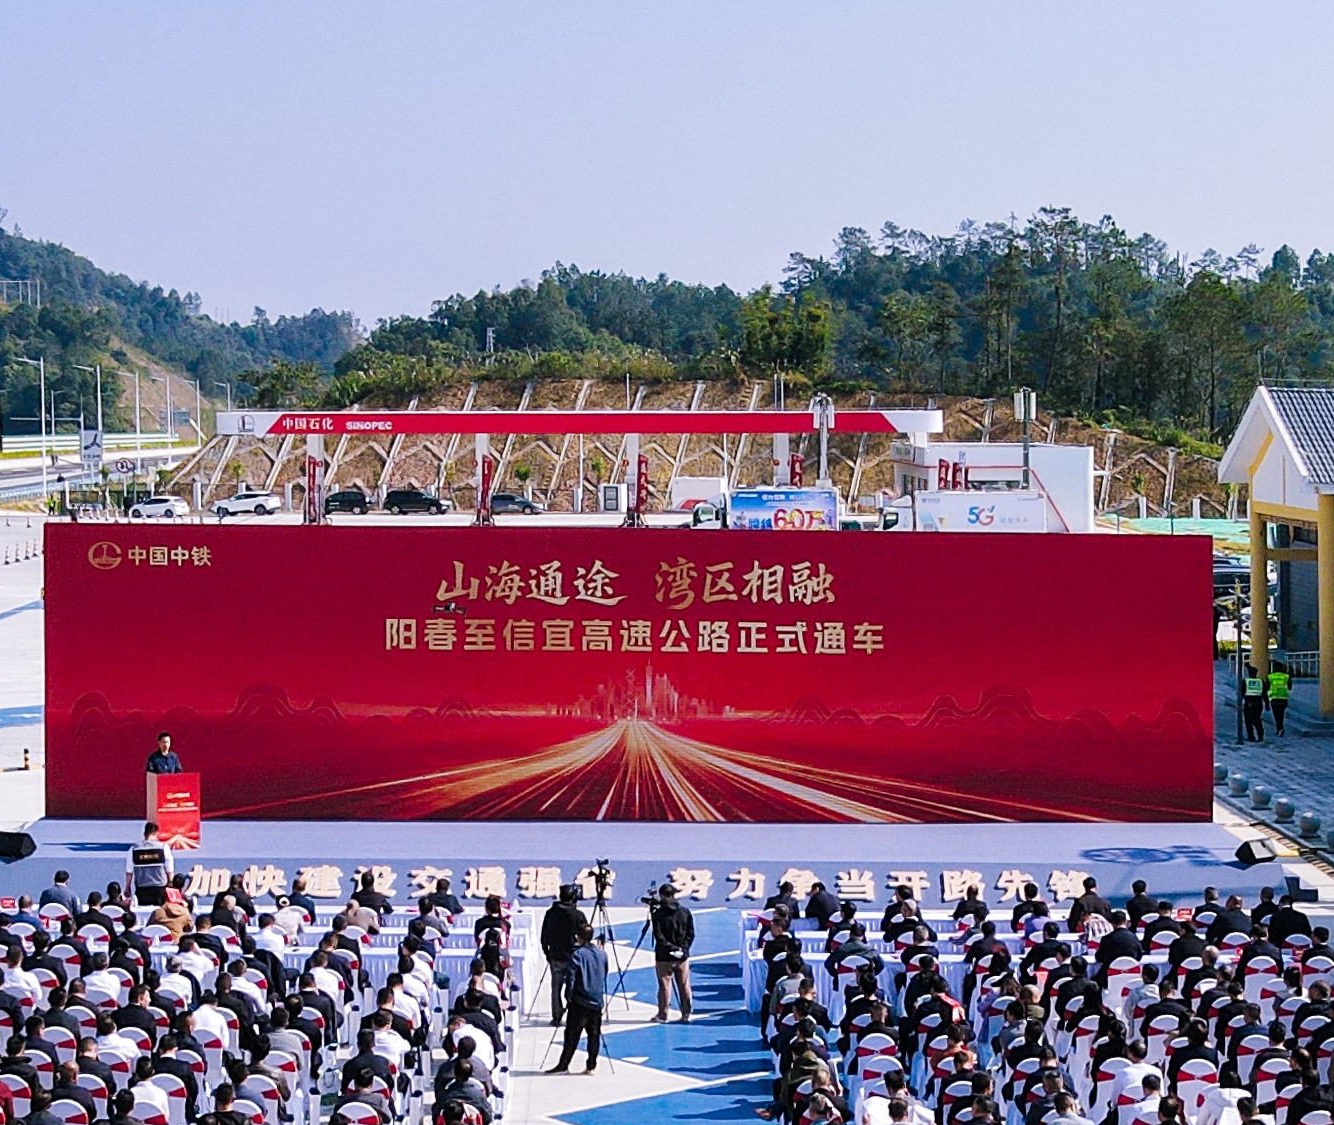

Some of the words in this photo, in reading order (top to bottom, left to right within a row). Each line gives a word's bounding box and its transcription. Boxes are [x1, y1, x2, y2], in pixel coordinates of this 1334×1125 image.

[282, 417, 334, 431] 中国石化
[346, 421, 393, 430] SINOPEC
[967, 506, 995, 526] 5G
[128, 545, 212, 567] 中国中铁
[435, 559, 627, 604] 山海通途
[653, 558, 835, 610] 湾区相融
[384, 618, 885, 655] 阳春至信宜高速公路正式通车
